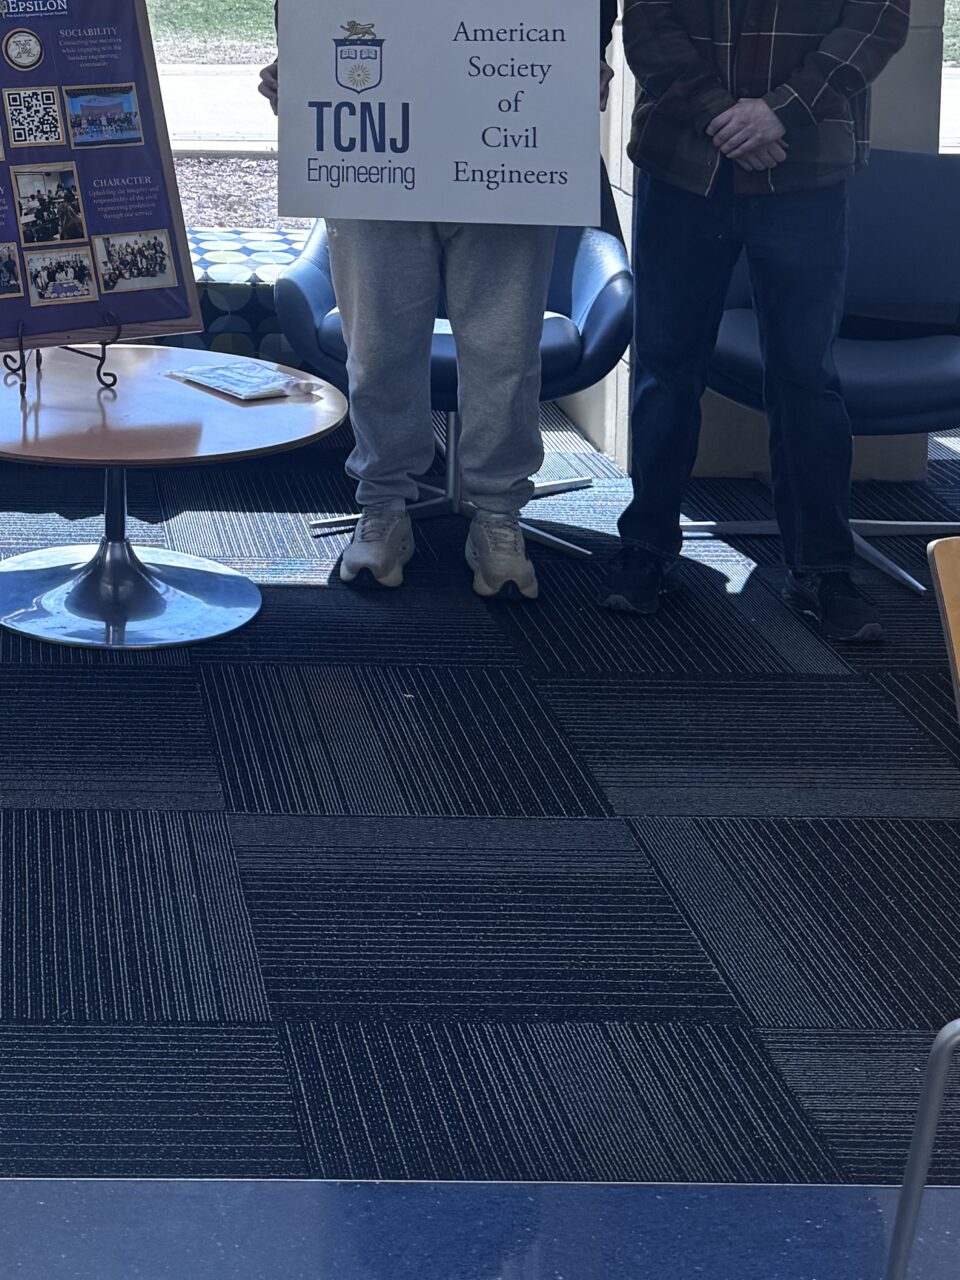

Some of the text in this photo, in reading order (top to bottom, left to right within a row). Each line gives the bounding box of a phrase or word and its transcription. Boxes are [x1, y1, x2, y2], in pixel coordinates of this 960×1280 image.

[59, 26, 117, 38] SOCIABILITY
[451, 21, 566, 43] American
[467, 55, 552, 84] Society
[497, 90, 525, 113] of
[307, 100, 410, 154] TCNJ
[481, 125, 538, 149] Civil
[93, 175, 152, 188] CHARACTER
[307, 157, 416, 191] Engineering
[452, 161, 568, 191] Engineers
